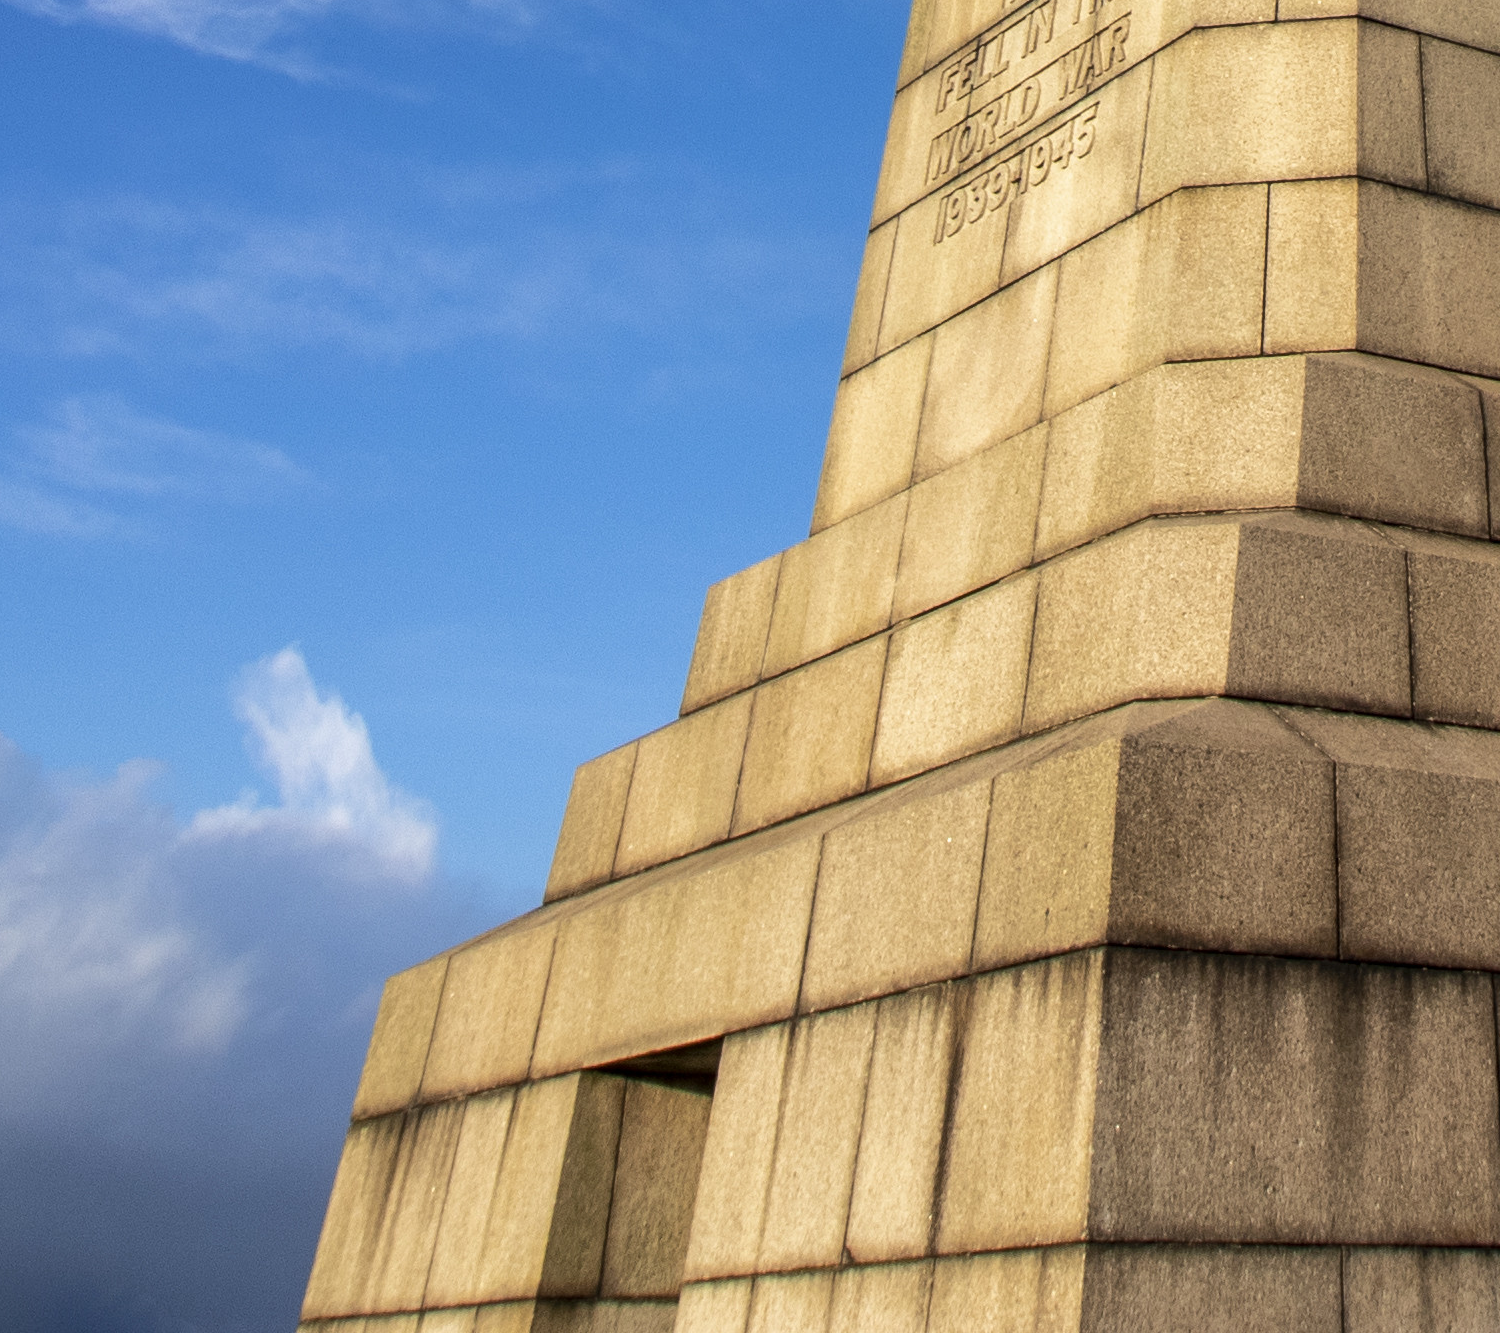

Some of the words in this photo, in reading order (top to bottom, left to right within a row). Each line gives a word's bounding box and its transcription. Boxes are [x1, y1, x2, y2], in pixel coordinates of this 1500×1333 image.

[926, 79, 1040, 183] WORLD
[1058, 13, 1132, 101] WAR
[936, 35, 1012, 113] FELL
[1020, 1, 1056, 59] IN
[933, 102, 1100, 245] 1939-1945
